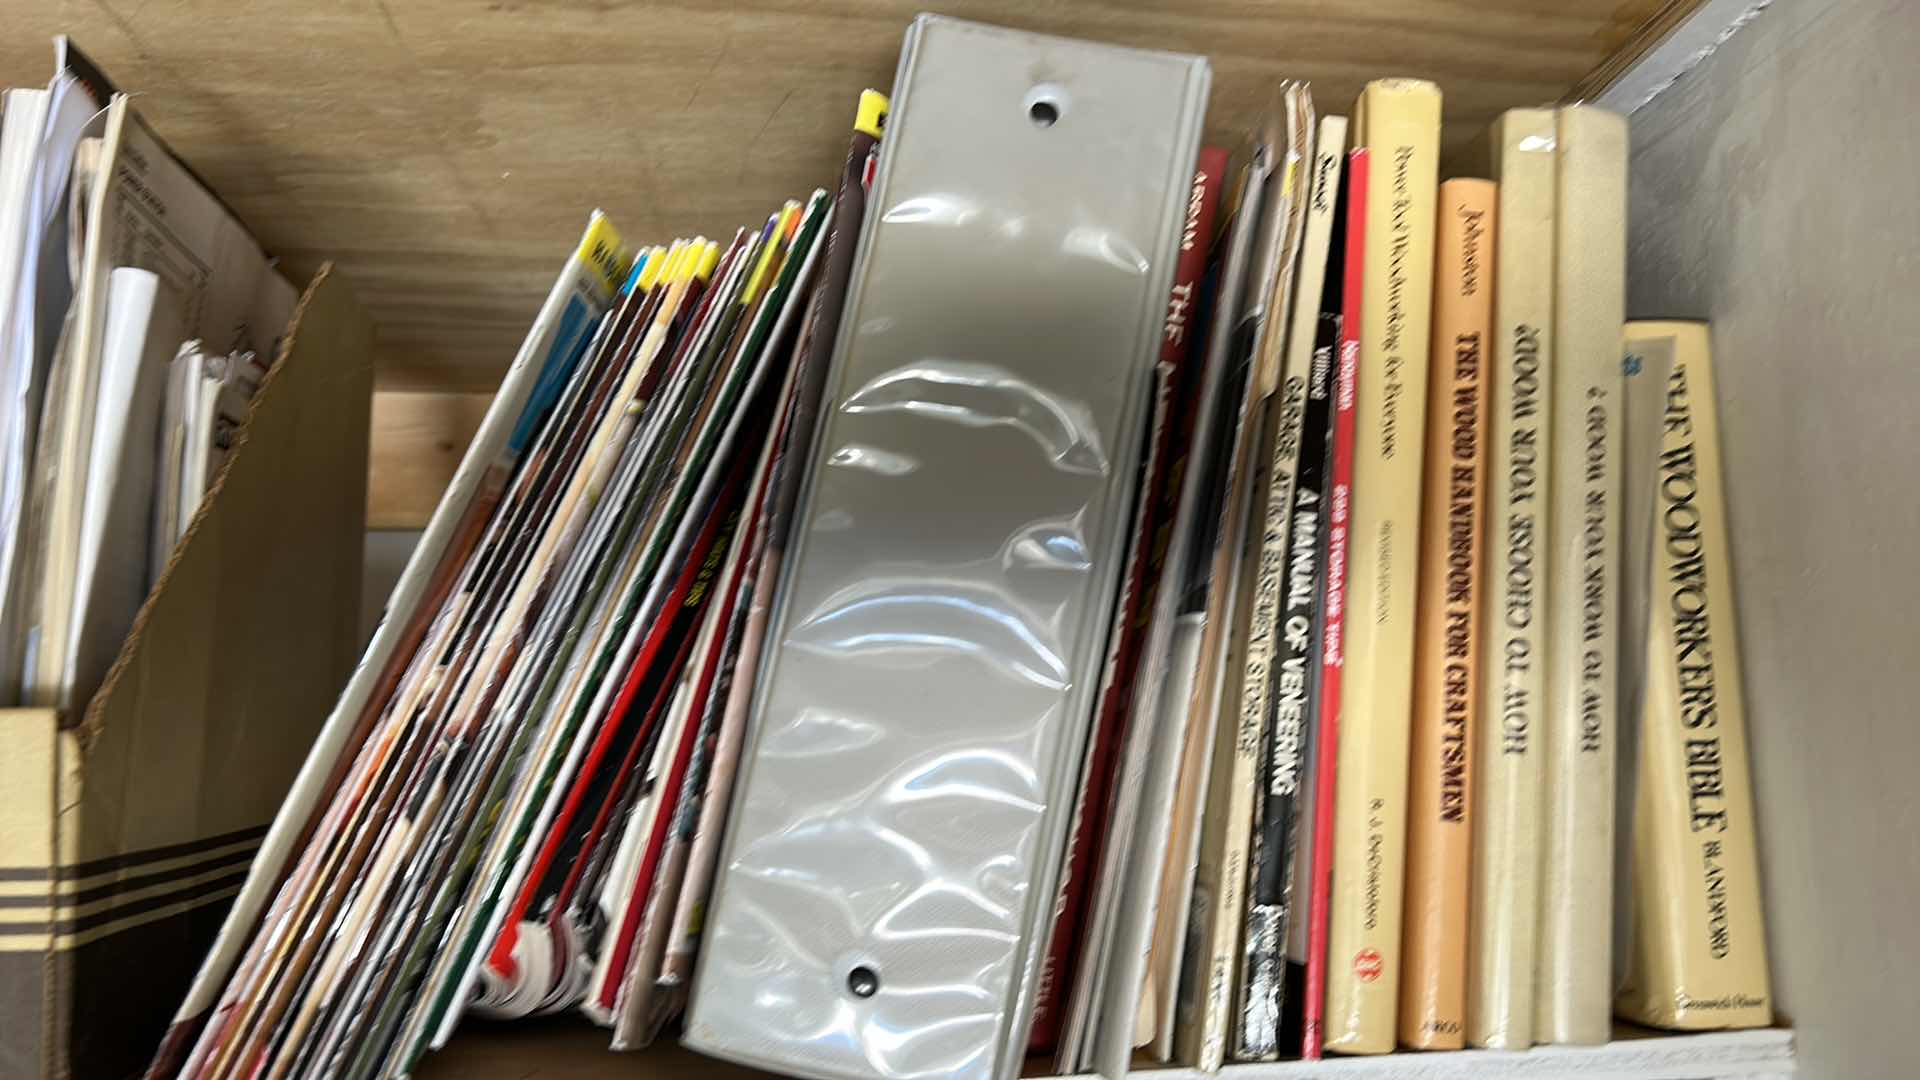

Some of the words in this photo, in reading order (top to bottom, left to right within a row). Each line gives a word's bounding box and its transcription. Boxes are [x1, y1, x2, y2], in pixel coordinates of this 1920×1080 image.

[1457, 203, 1484, 297] Johnston
[1455, 331, 1480, 381] THE
[1452, 384, 1478, 460] WOOD
[1295, 488, 1320, 507] A
[1510, 427, 1537, 505] YOUR
[1287, 510, 1318, 611] MANUAL
[1446, 464, 1475, 604] HANDBOOK
[1584, 489, 1607, 561] YOUR
[1248, 549, 1280, 654] BASEMENT
[1505, 515, 1535, 630] CHOOSE
[1584, 563, 1604, 641] WORK
[1663, 364, 1691, 437] THE
[1685, 737, 1728, 833] BIBLE
[1284, 615, 1309, 653] OF
[1446, 610, 1472, 659] FOR
[1504, 637, 1531, 671] TO
[1583, 650, 1602, 680] TO
[1238, 663, 1265, 757] STORAGE
[1270, 656, 1309, 795] VENEERING
[1440, 664, 1469, 823] CRAFTSMEN
[1503, 685, 1528, 755] HOW
[1582, 689, 1601, 752] HOW
[1702, 840, 1730, 959] BLANDFORD
